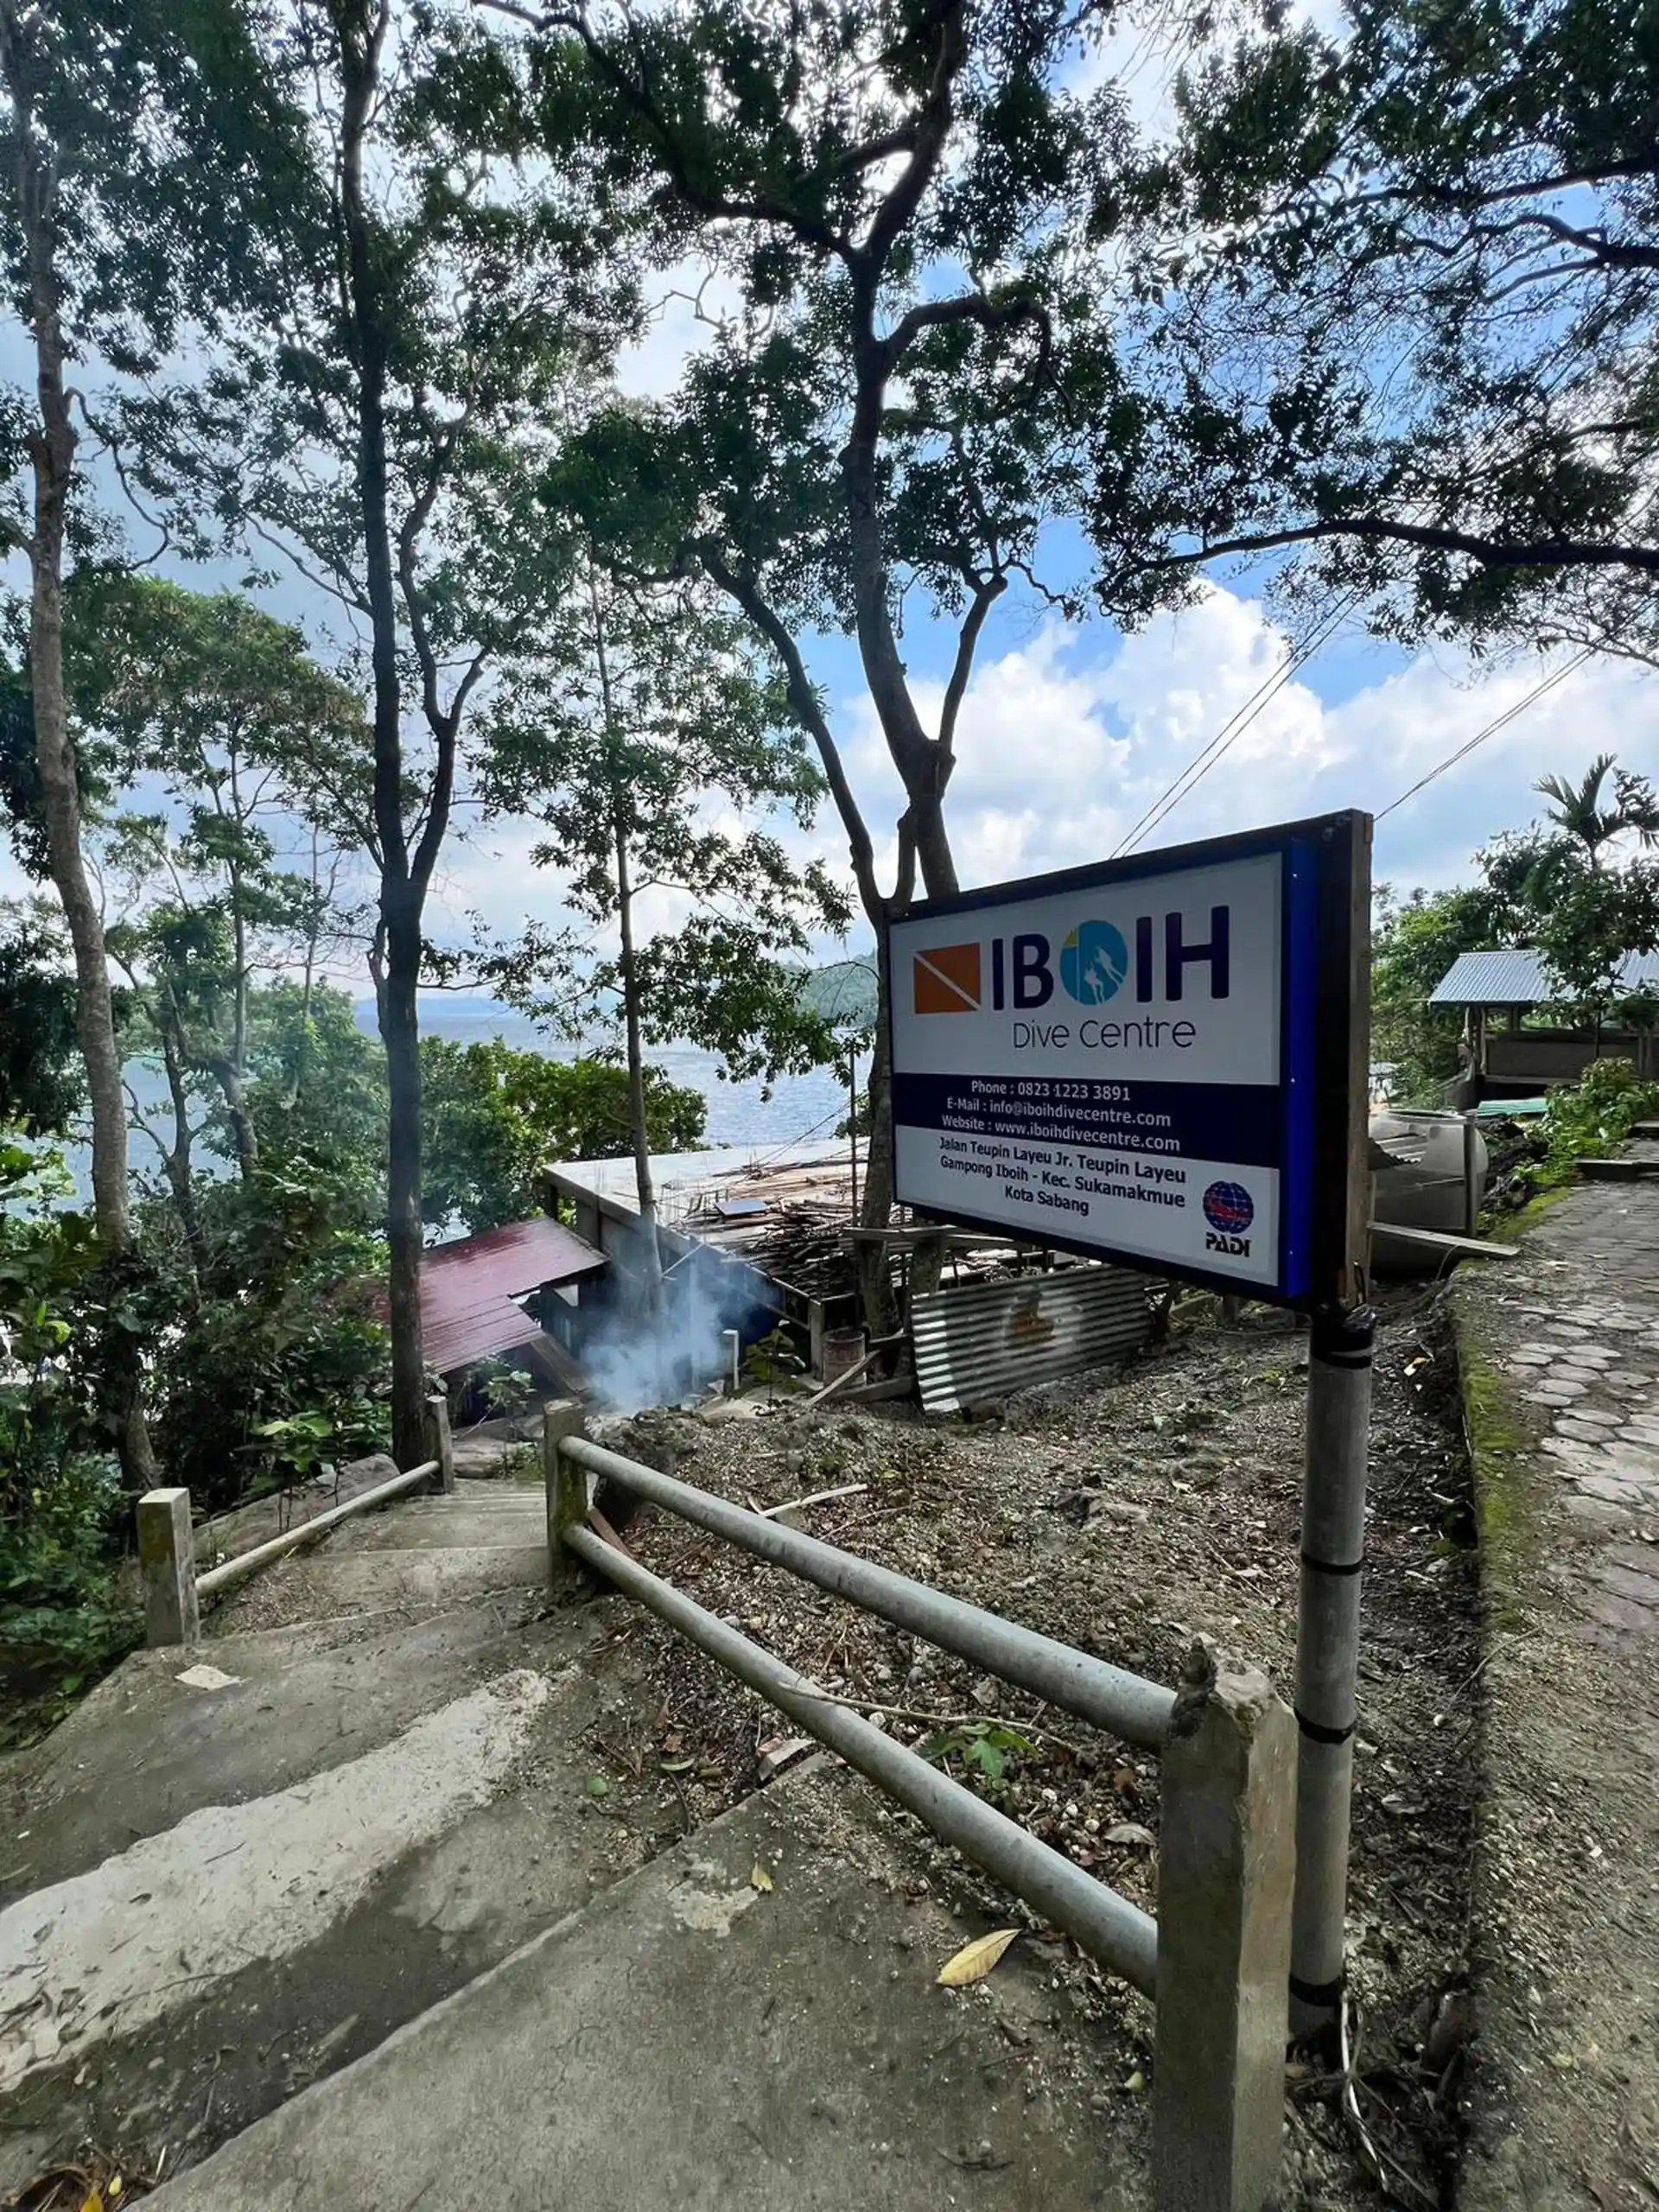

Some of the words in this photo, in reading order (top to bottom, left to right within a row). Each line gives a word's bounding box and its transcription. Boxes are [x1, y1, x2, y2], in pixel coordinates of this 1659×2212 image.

[992, 906, 1230, 1011] IBOIH
[1013, 1020, 1070, 1048] Dive
[1079, 1015, 1196, 1048] Centre
[971, 1080, 1007, 1095] Phone
[1018, 1082, 1050, 1096] 0823
[1053, 1084, 1089, 1099] 1223
[1093, 1085, 1131, 1101] 3891
[947, 1096, 980, 1112] E-Mail
[989, 1099, 1171, 1127] info@iboihdivecentre.com
[942, 1115, 984, 1130] Website
[995, 1122, 1180, 1151] www.iboihdivecentre.com
[939, 1137, 967, 1152] Jalan
[970, 1141, 1009, 1159] Teupin
[1014, 1147, 1052, 1165] Layeu
[1055, 1152, 1073, 1167] Jr.
[1077, 1154, 1129, 1176] Teupin
[1135, 1161, 1185, 1184] Layeu
[940, 1155, 992, 1178] Gampong
[995, 1164, 1028, 1181] Iboih
[1042, 1171, 1071, 1188] Kec.
[1075, 1176, 1185, 1207] Sukamakmue
[1005, 1185, 1033, 1202] Kota
[1037, 1191, 1089, 1217] Sabang
[1205, 1231, 1252, 1258] PADI
